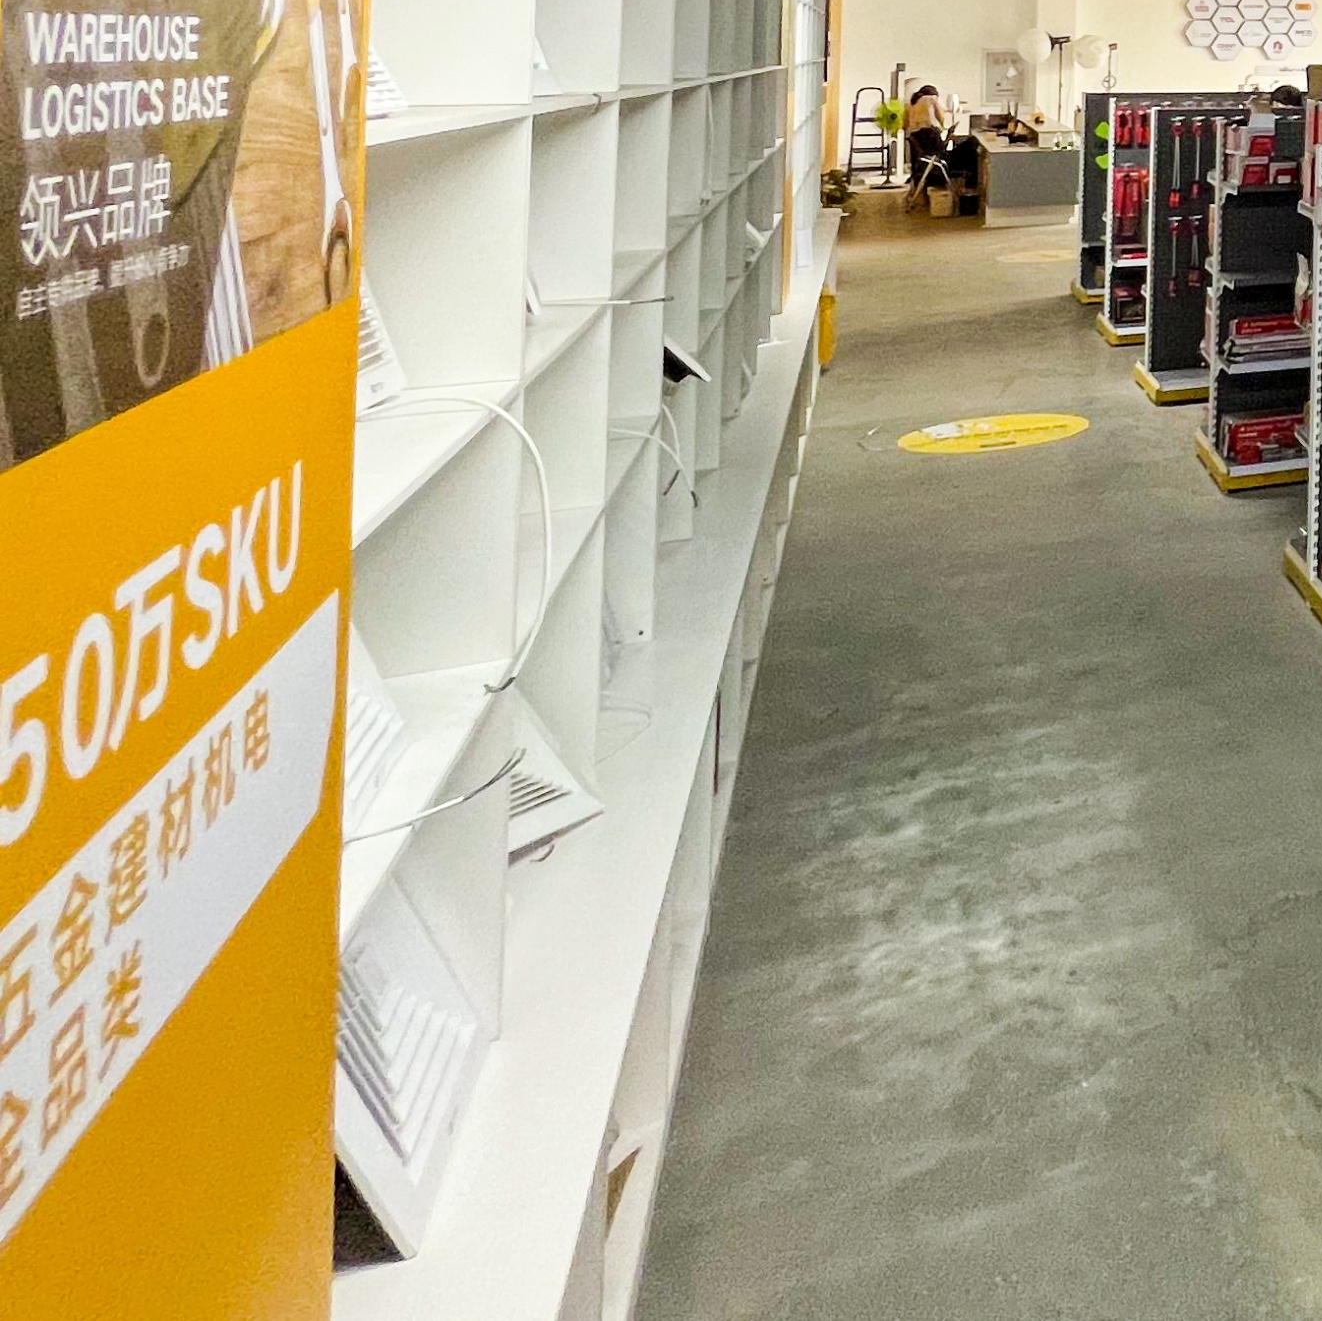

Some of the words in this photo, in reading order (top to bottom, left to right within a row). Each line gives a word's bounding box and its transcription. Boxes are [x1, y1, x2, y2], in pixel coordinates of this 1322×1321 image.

[27, 12, 200, 65] WAREHOUSE
[22, 78, 164, 140] LOGISTICS
[172, 76, 230, 121] BASE
[20, 153, 172, 266] 领兴品牌
[0, 460, 304, 848] 50万SKU
[0, 688, 273, 1058] 五金建材机电
